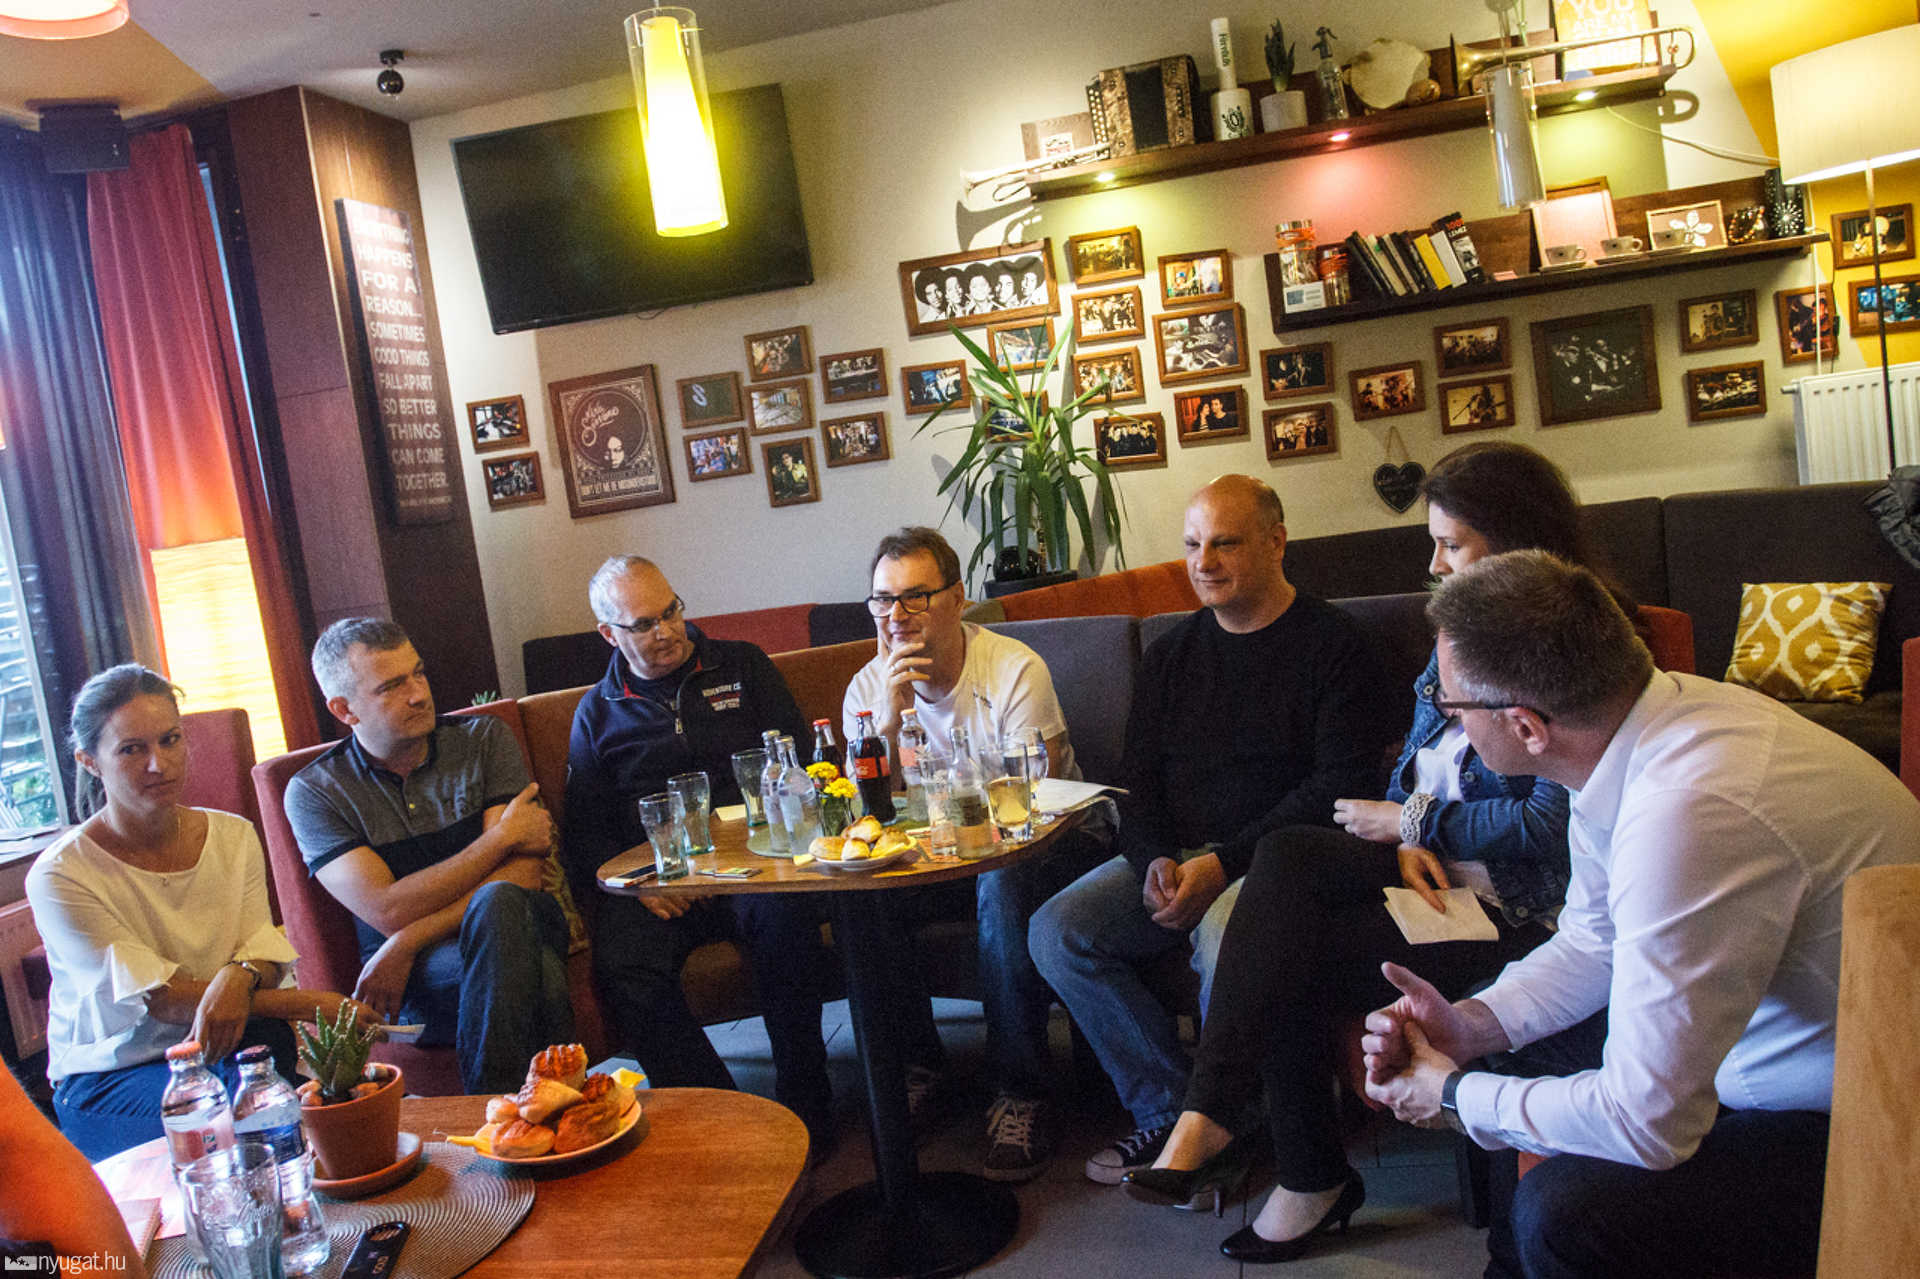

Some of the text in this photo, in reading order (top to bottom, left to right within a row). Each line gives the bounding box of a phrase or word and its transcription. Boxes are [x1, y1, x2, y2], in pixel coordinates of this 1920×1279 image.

[361, 270, 418, 294] FOR A
[369, 321, 425, 342] SOMETIMES
[375, 347, 430, 367] GOOD THINGS
[378, 372, 433, 391] FALL APART
[383, 398, 438, 415] SO BETTER
[387, 422, 442, 440] THINGS
[392, 447, 445, 465] CAN COME
